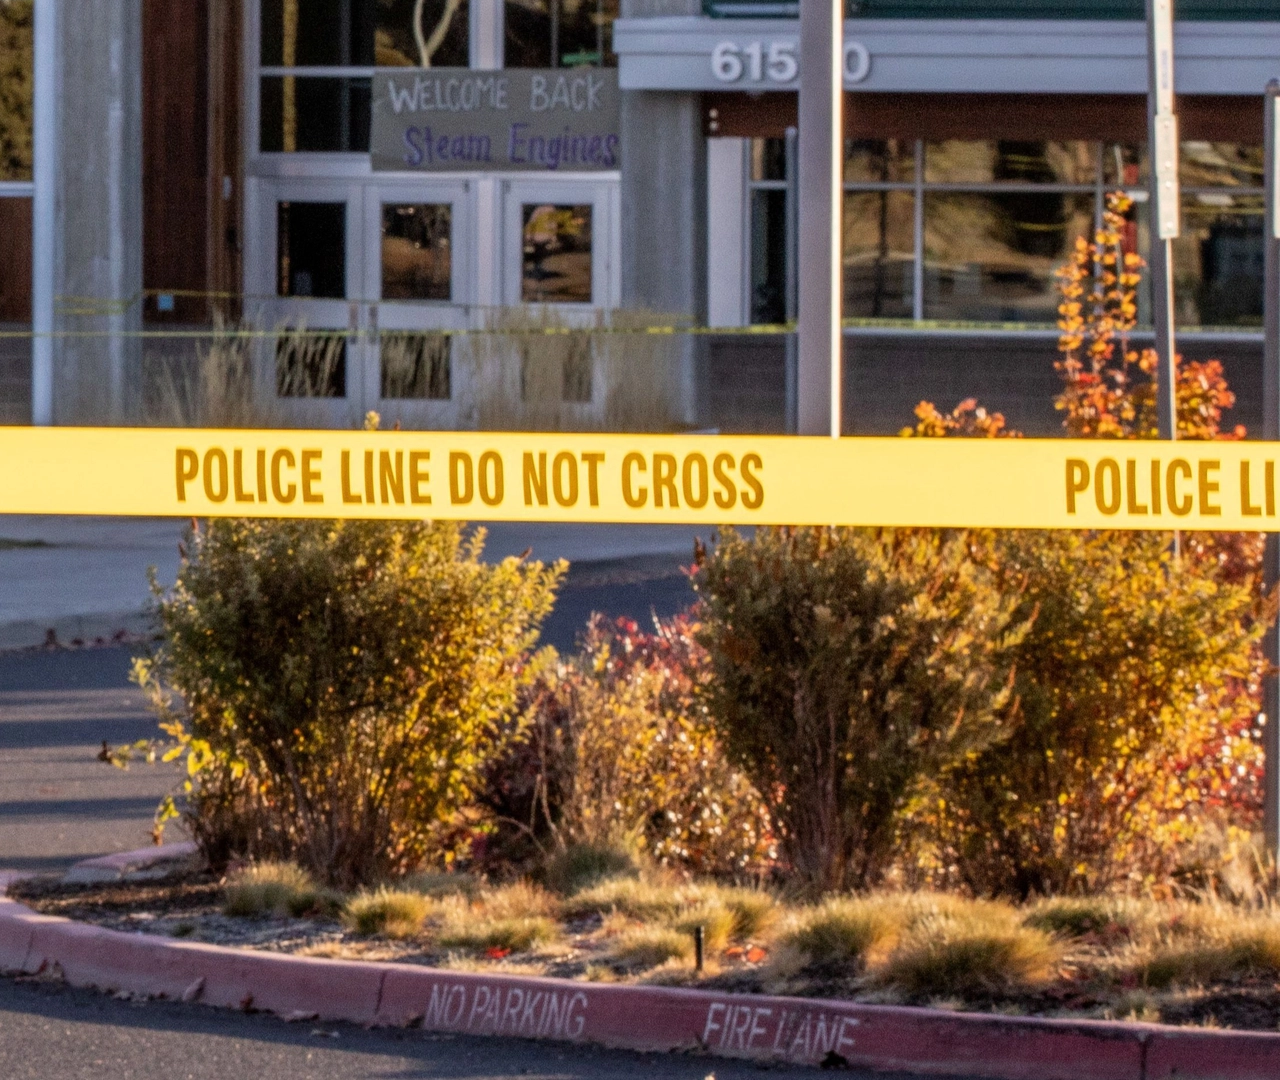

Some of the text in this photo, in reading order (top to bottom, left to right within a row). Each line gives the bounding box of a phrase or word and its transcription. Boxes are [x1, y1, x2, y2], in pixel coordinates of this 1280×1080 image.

[711, 41, 870, 83] 6150
[390, 74, 604, 113] WELCOME BACK
[403, 122, 620, 170] Steam Engines
[175, 447, 765, 510] POLICE LINE DO NOT CROSS
[1065, 457, 1276, 517] POLICE LI
[425, 983, 588, 1038] NO PARKING
[702, 1002, 859, 1055] FIRE LANE
